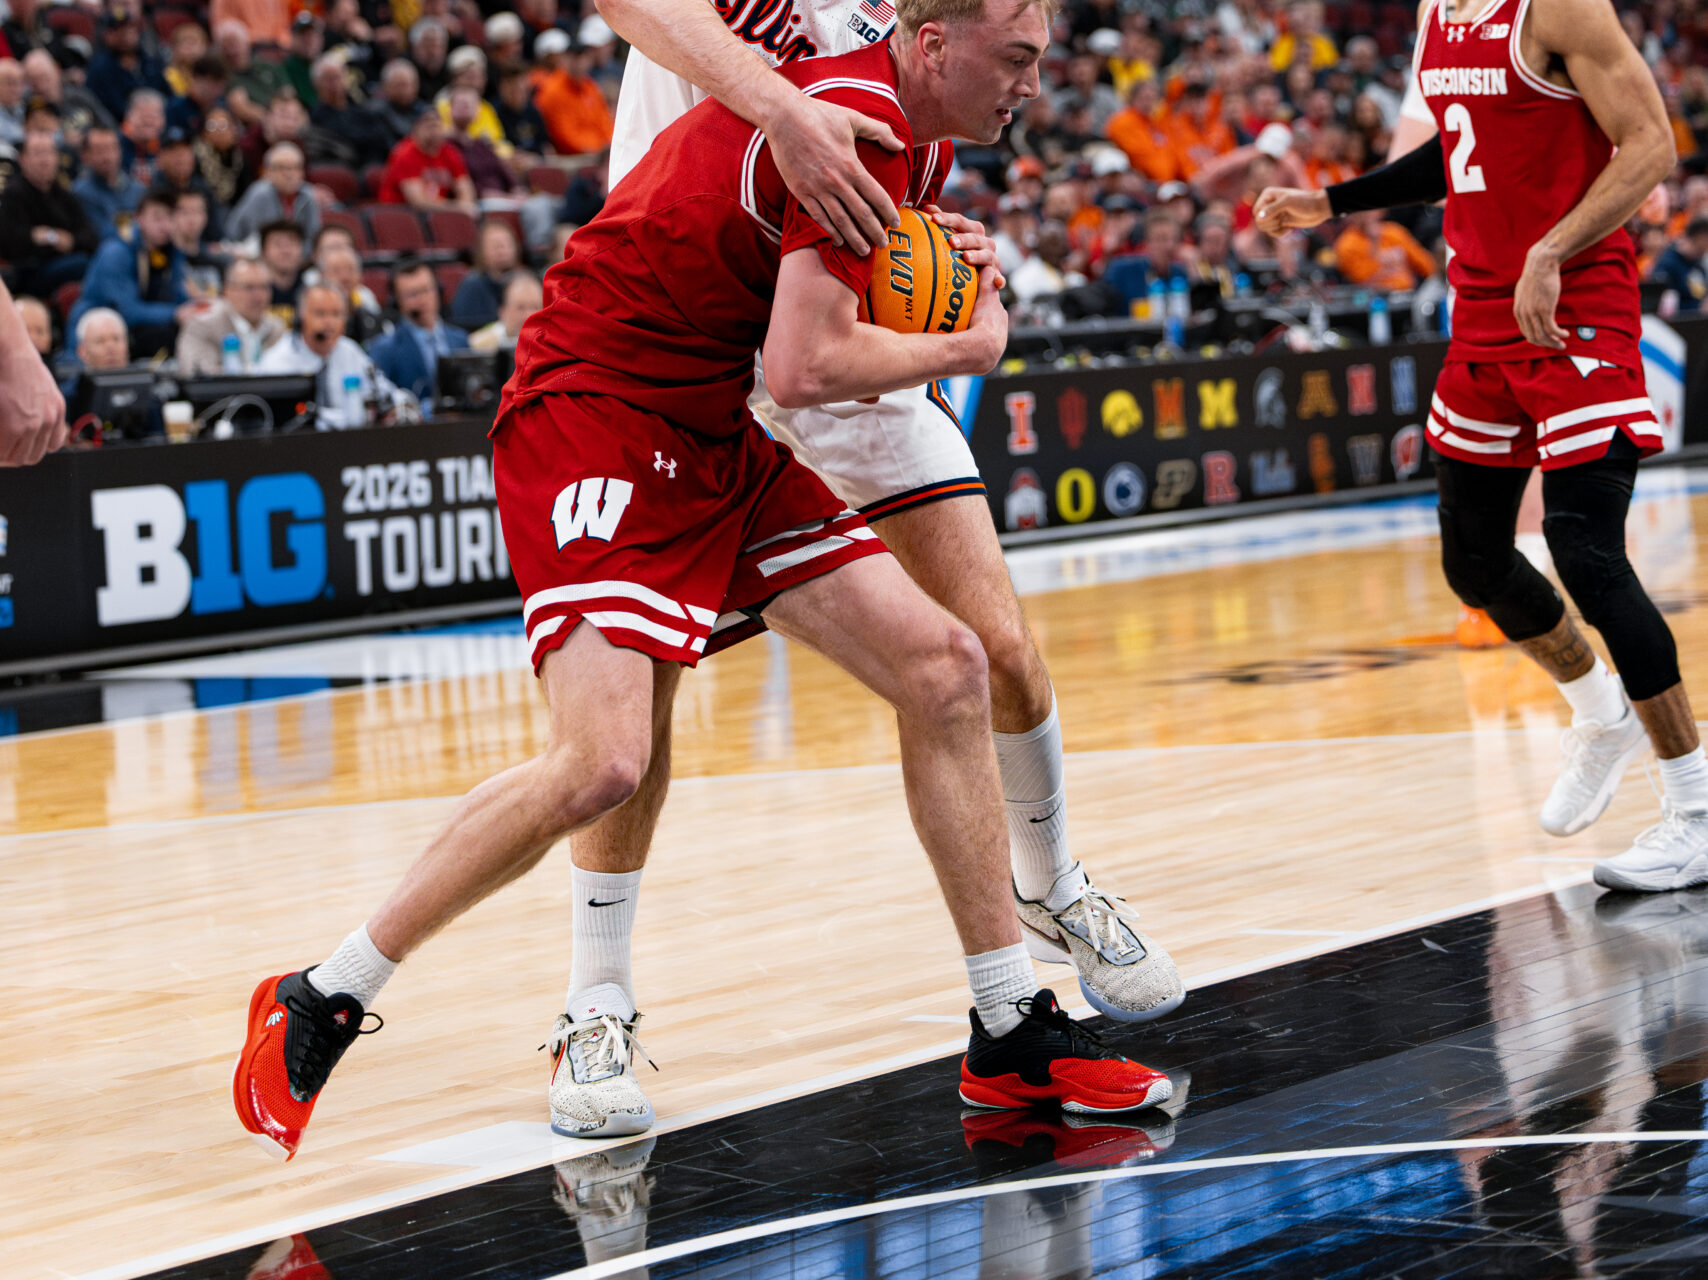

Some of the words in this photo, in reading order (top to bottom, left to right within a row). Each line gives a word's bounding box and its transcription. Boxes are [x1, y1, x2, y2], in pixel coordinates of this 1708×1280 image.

[1420, 67, 1509, 97] WISCONSIN
[1444, 103, 1487, 194] 2
[888, 229, 914, 297] EVO
[904, 297, 914, 324] NXT
[340, 460, 433, 514] 2026
[436, 453, 497, 505] TIA
[550, 477, 634, 553] W
[1055, 466, 1097, 523] O
[1201, 450, 1241, 504] R
